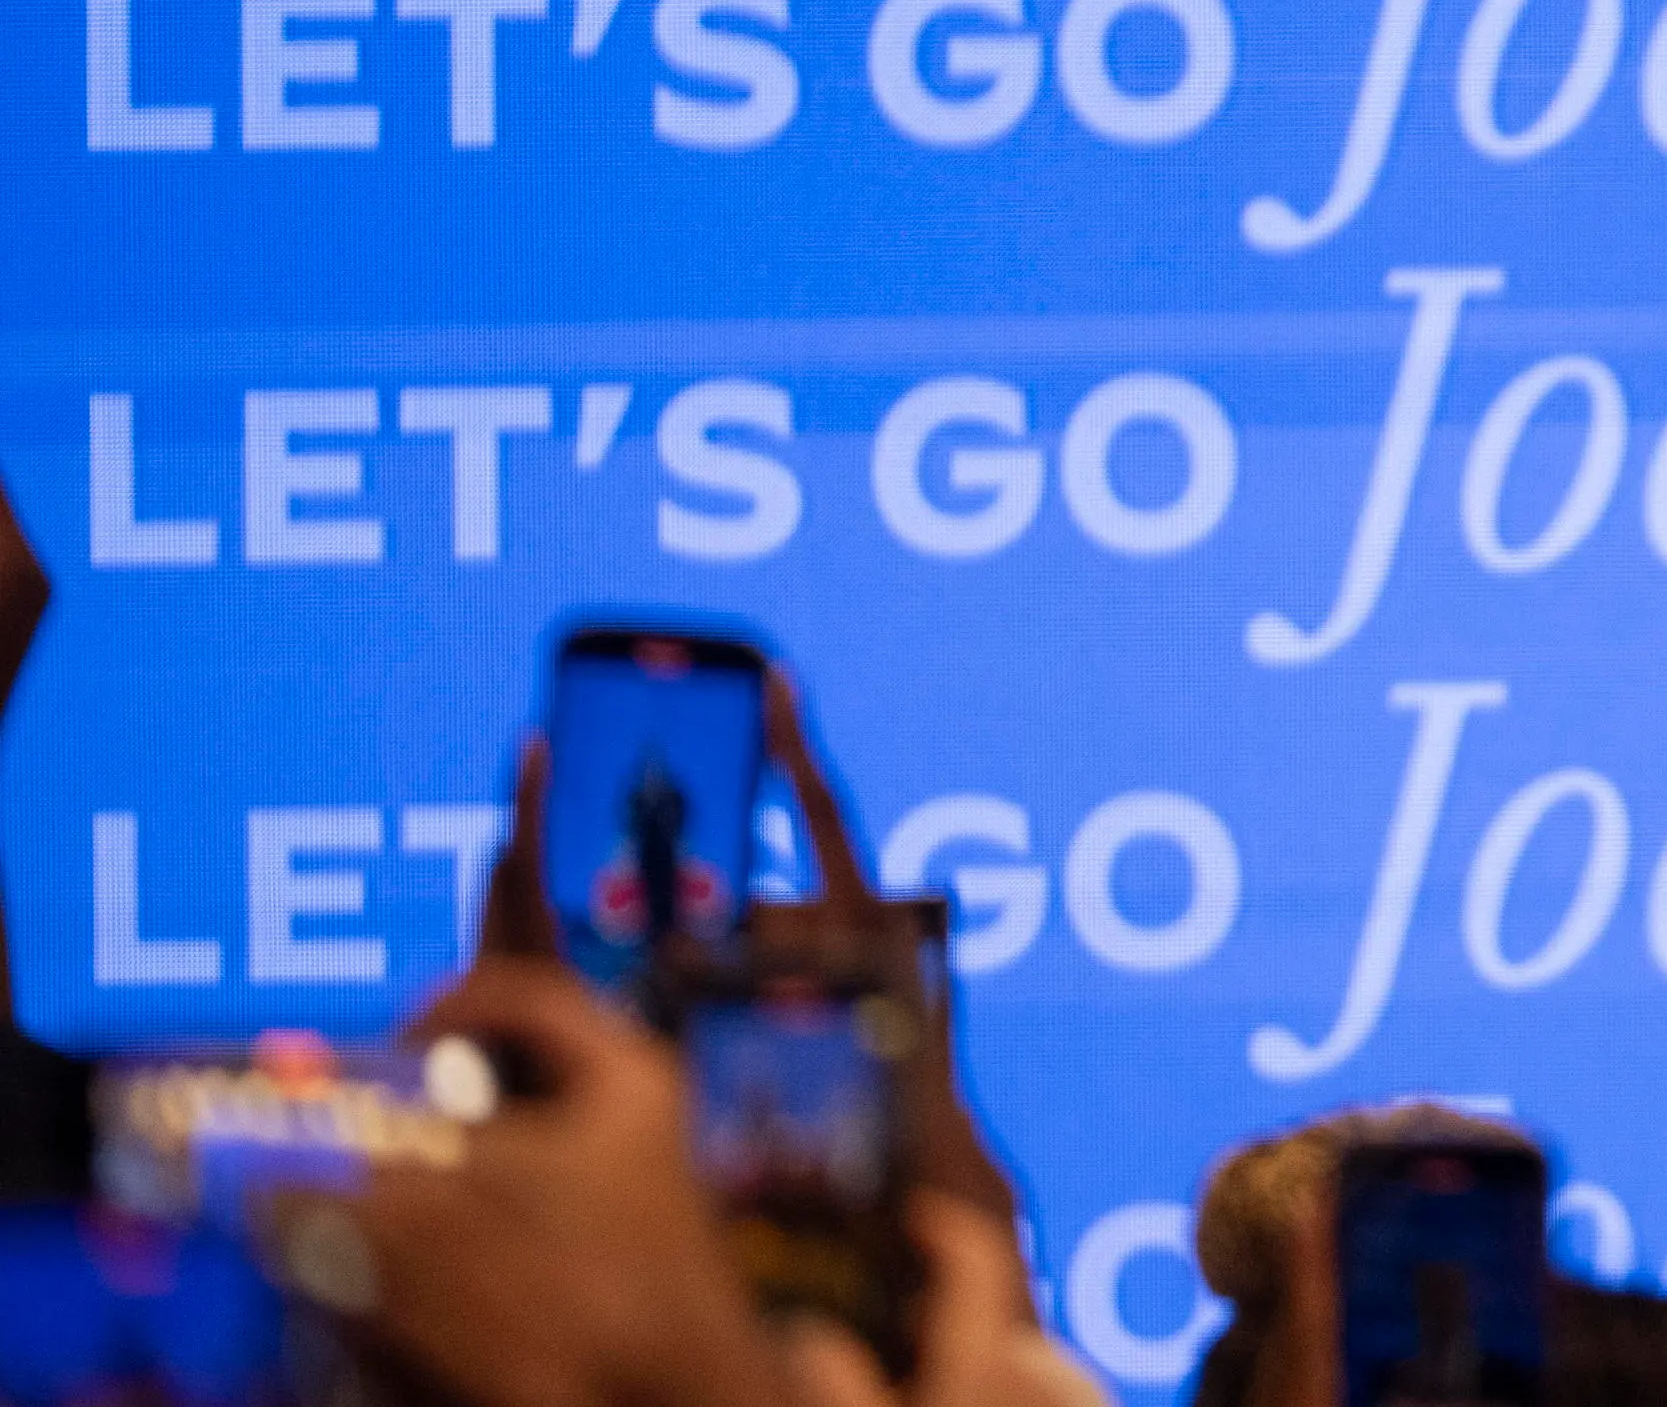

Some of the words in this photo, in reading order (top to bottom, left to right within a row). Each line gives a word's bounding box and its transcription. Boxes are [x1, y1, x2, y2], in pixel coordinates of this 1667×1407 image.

[88, 376, 801, 569] LET'S
[870, 373, 1237, 560] GO
[878, 792, 1240, 979] GO
